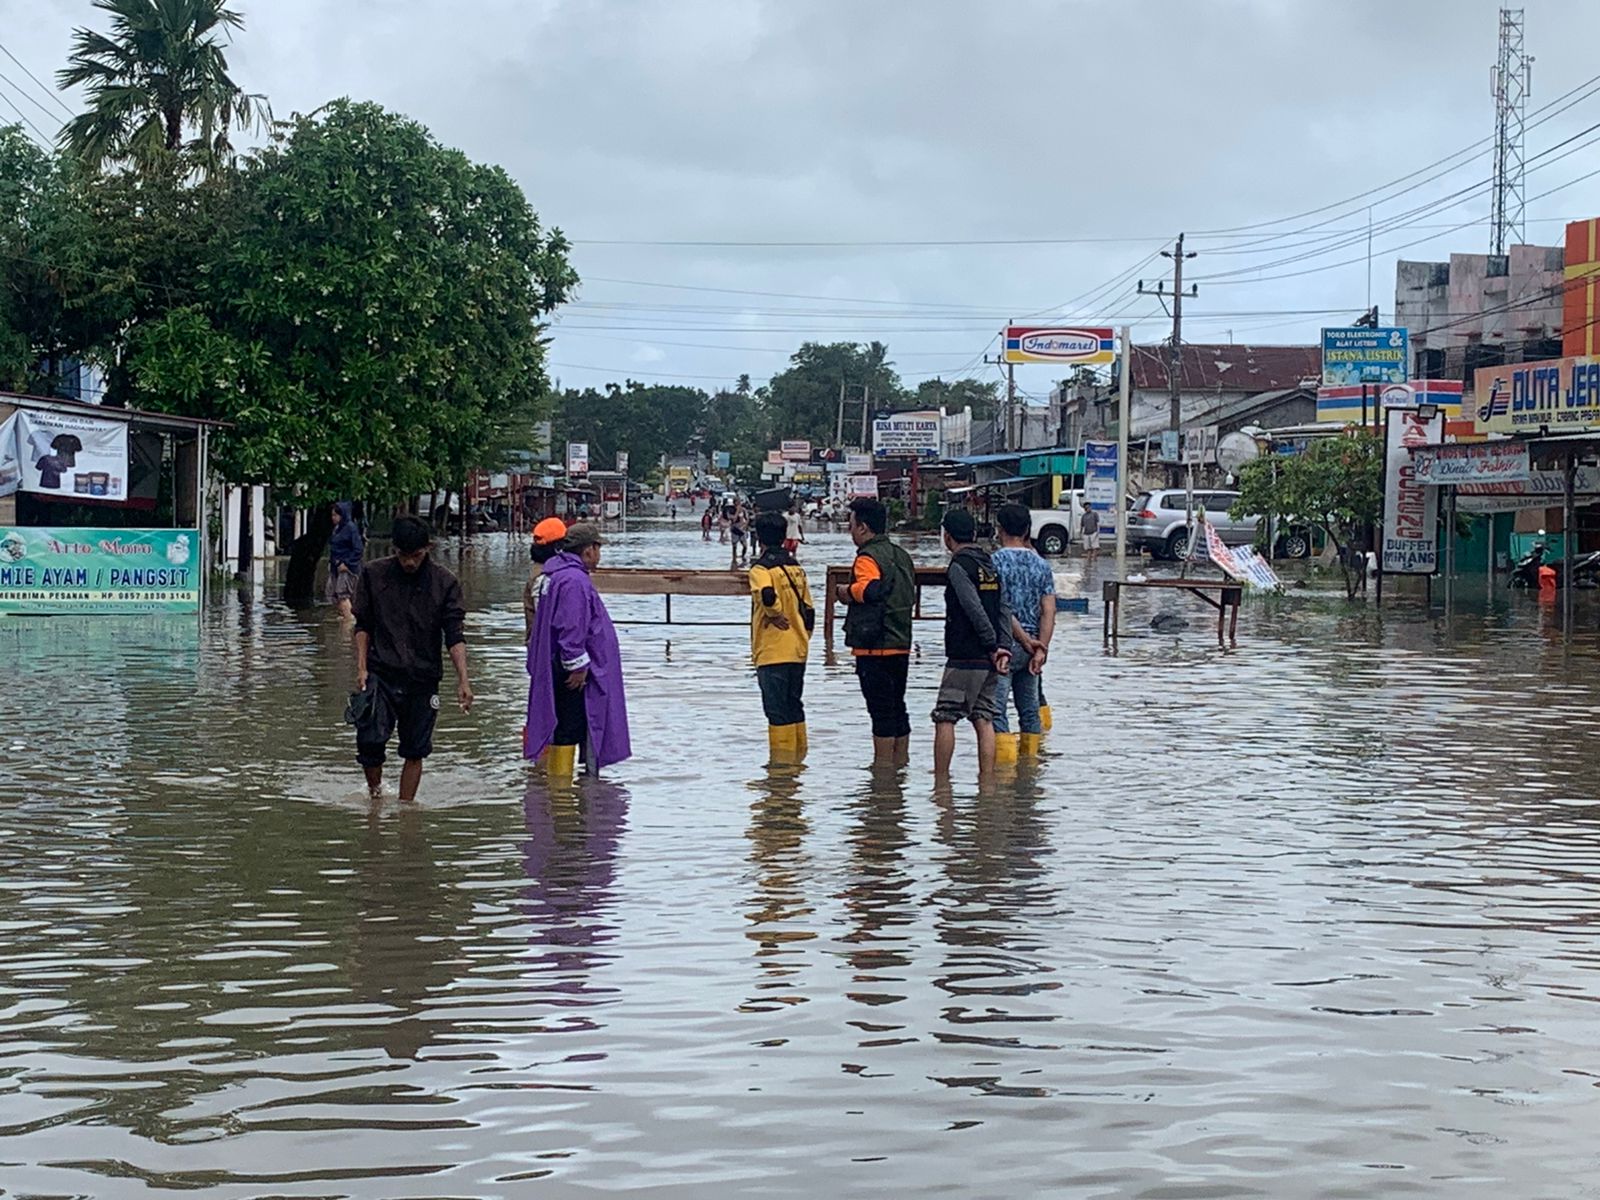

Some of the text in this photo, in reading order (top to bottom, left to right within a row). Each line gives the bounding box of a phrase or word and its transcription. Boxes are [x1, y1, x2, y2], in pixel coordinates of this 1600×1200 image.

[1026, 337, 1094, 350] Indomaret
[1327, 349, 1404, 361] ISTANA LISTRIK
[1513, 367, 1559, 411] DUTA
[100, 537, 153, 555] Moro
[1387, 539, 1432, 551] BUFFET
[1384, 551, 1435, 563] MINANG
[0, 568, 34, 586] MIE
[42, 568, 88, 586] AYAM
[110, 568, 190, 586] PANGSIT
[49, 592, 90, 600] PESANAN
